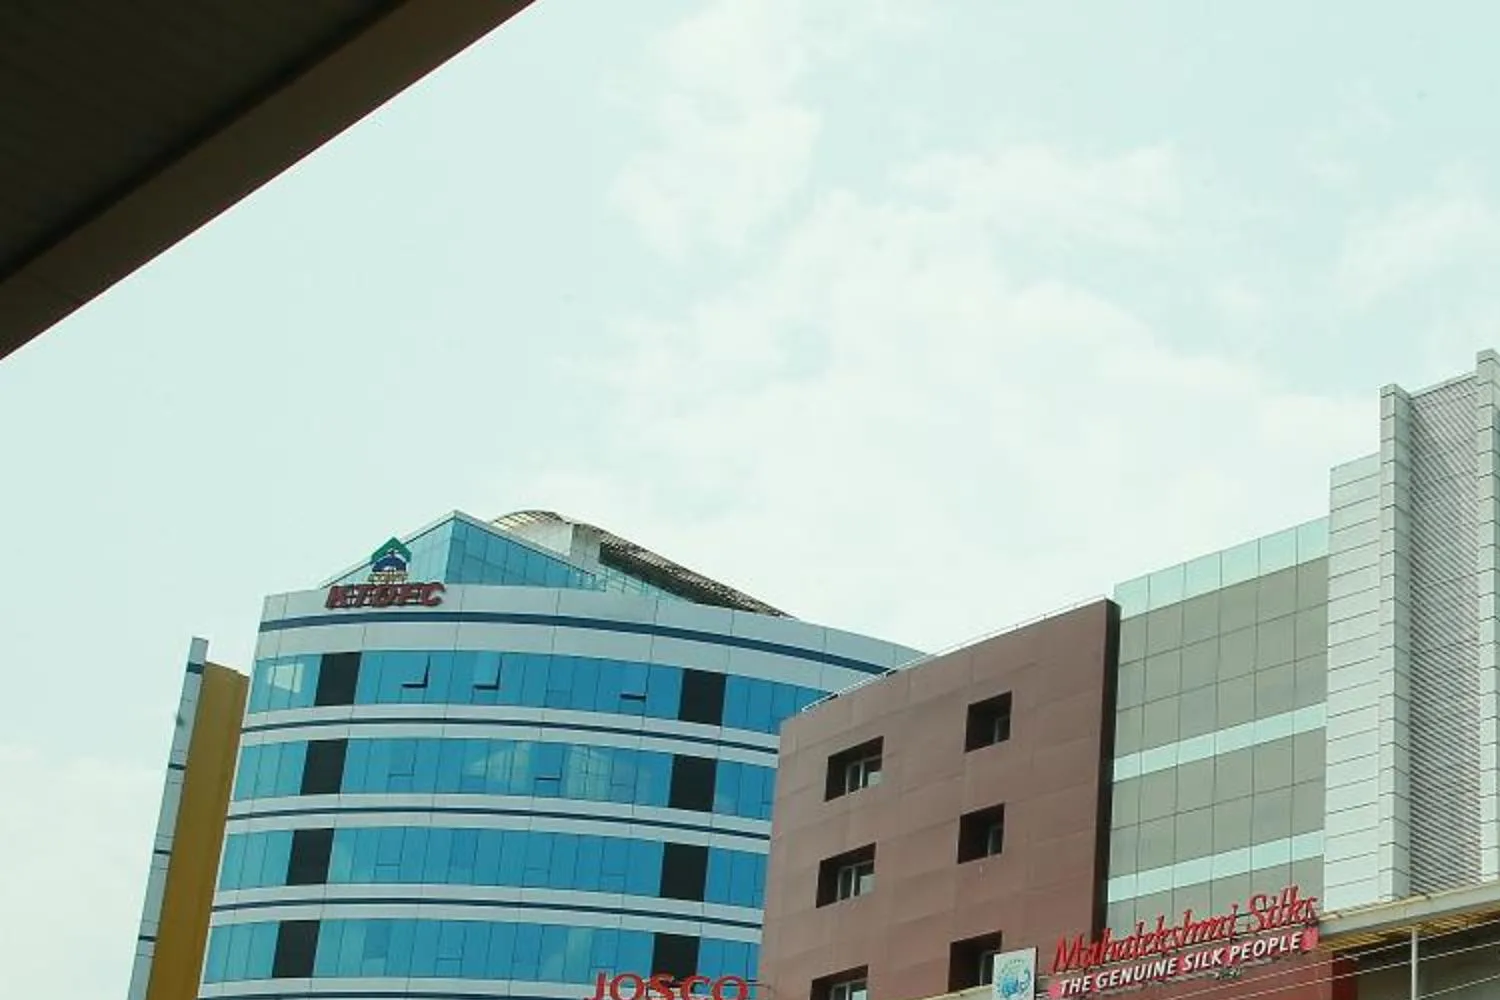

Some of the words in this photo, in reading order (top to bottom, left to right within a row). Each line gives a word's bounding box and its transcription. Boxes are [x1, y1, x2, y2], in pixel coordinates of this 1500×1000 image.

[1058, 975, 1091, 997] THE
[1095, 957, 1178, 990] GENUINE
[1181, 948, 1224, 973] SILK
[1228, 930, 1303, 963] PEOPLE
